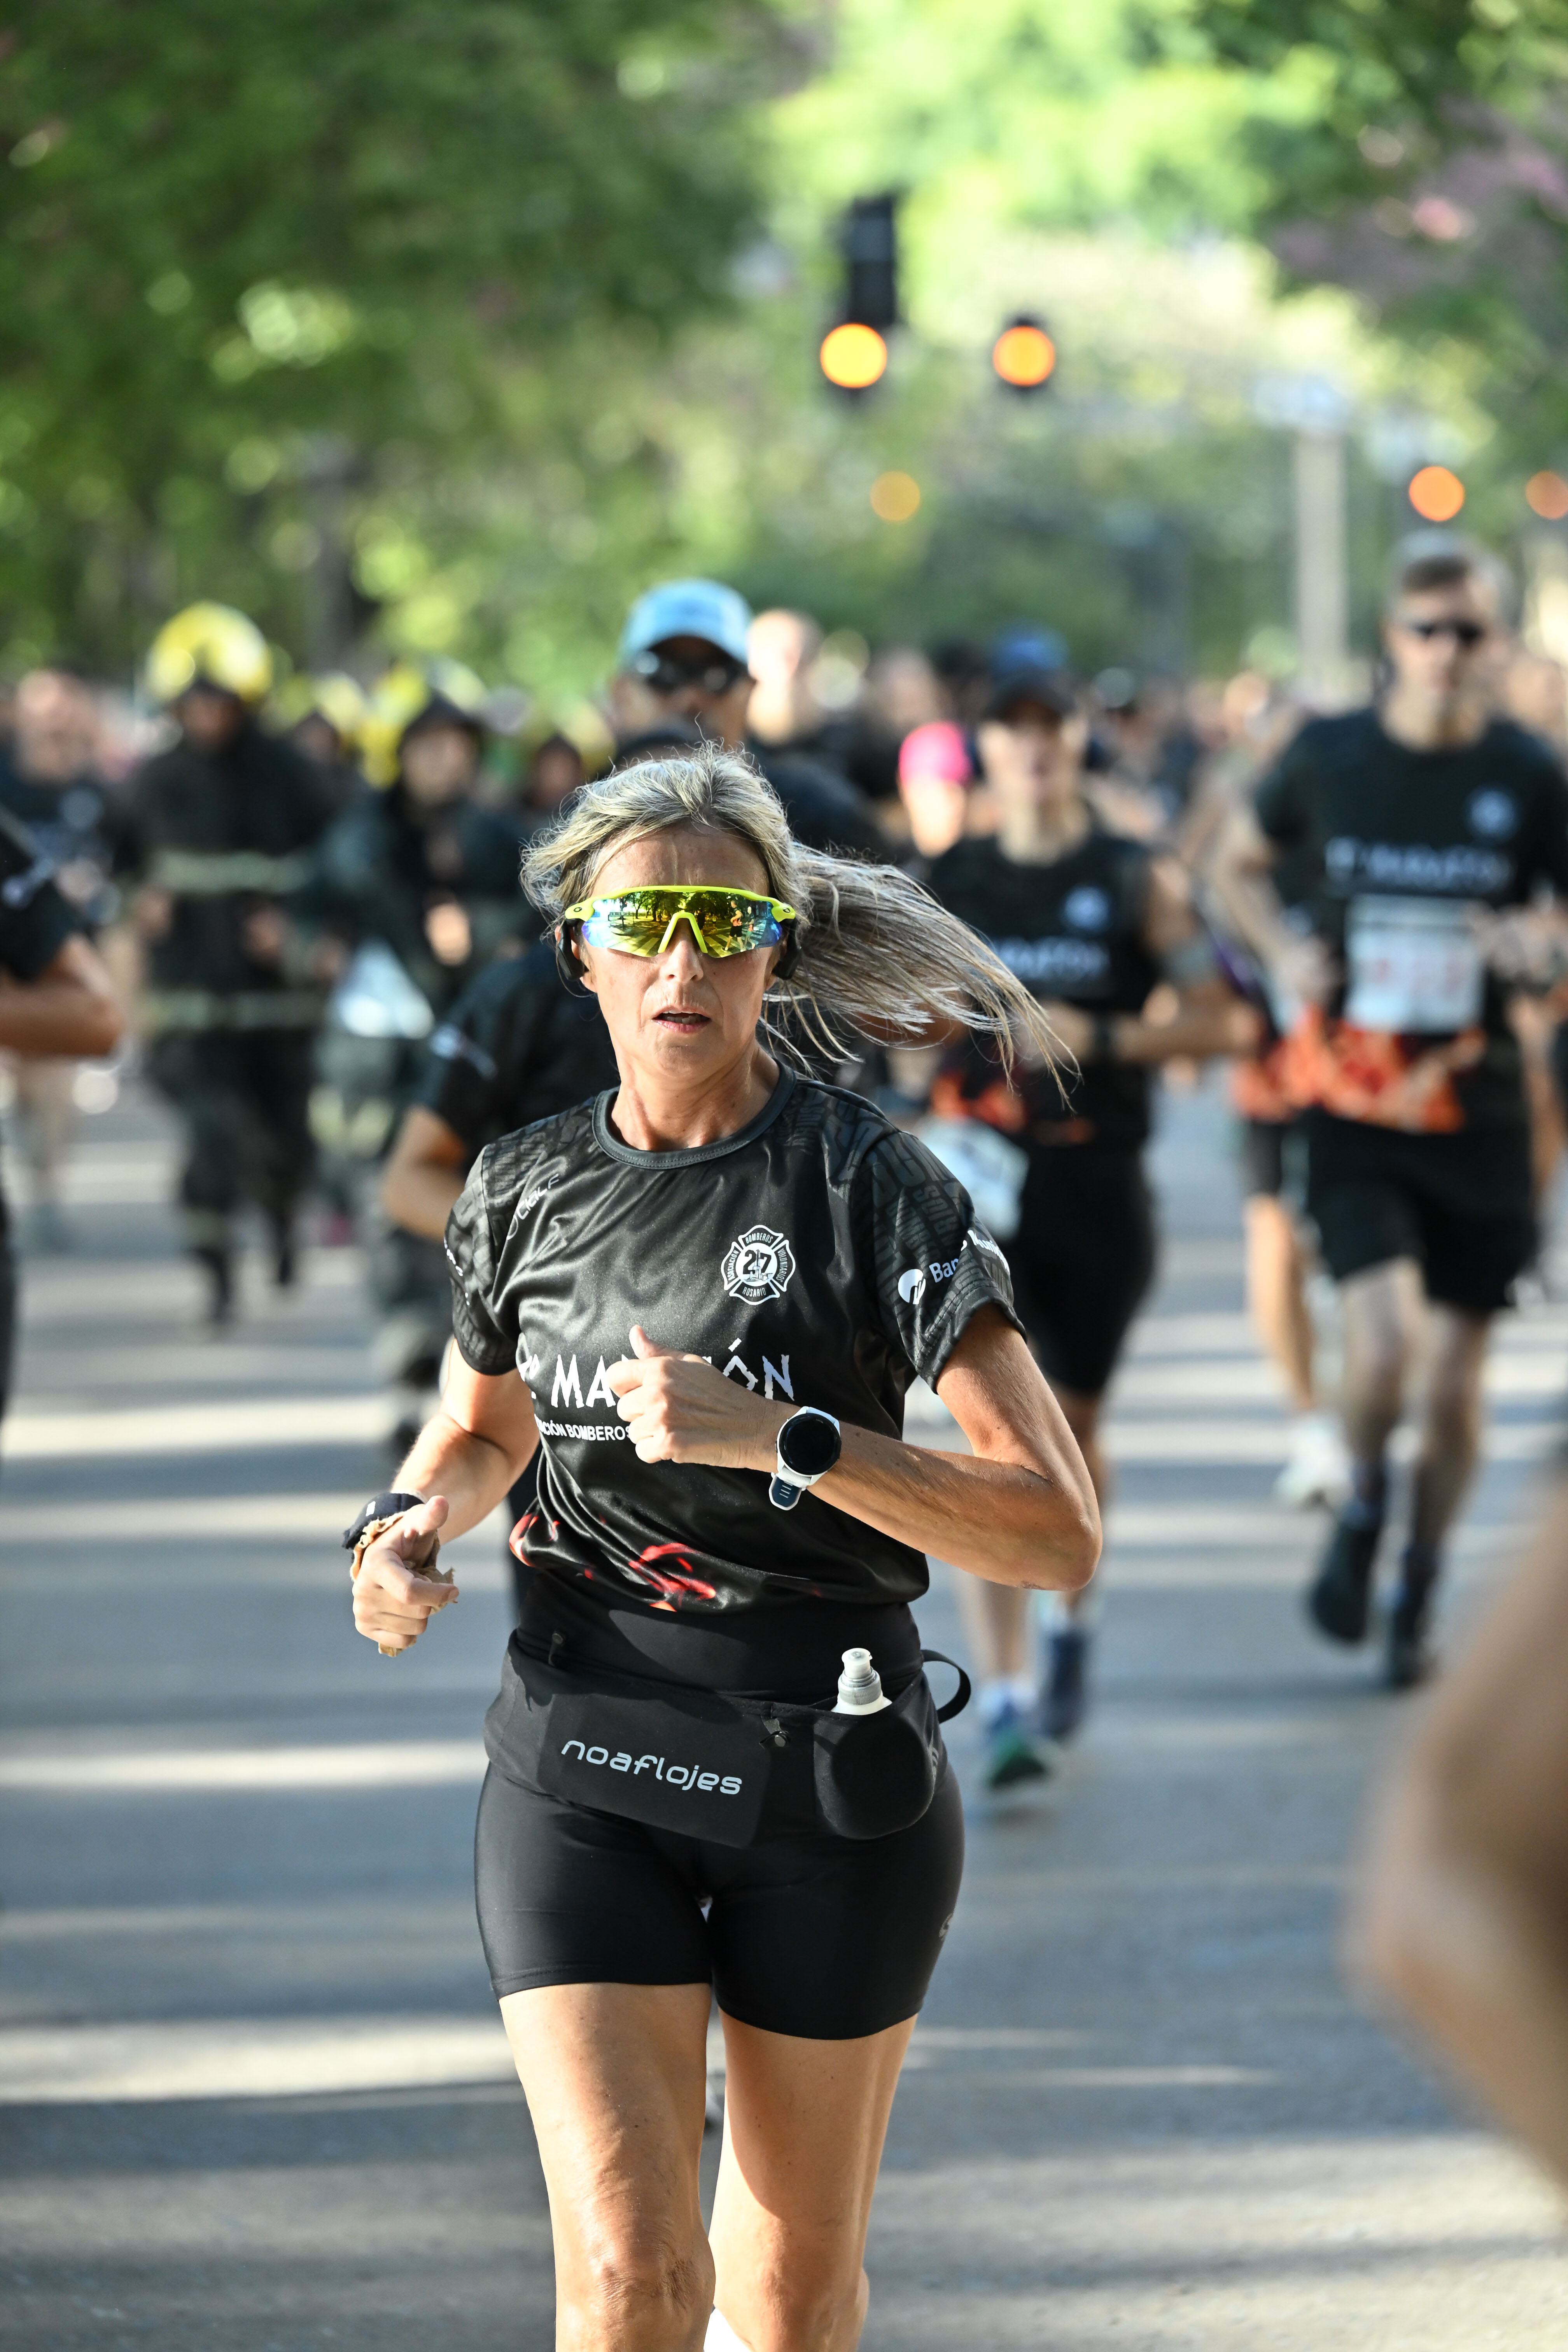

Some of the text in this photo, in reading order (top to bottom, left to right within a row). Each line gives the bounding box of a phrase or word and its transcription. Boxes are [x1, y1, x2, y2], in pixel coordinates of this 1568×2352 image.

[745, 1232, 774, 1244] BOMBEROS
[742, 1249, 772, 1275] 27
[775, 1248, 788, 1283] VOLUNTARIOS
[742, 1286, 766, 1297] ROSARIO
[551, 1337, 795, 1409] MAÓN
[561, 1740, 742, 1795] noaflojes
